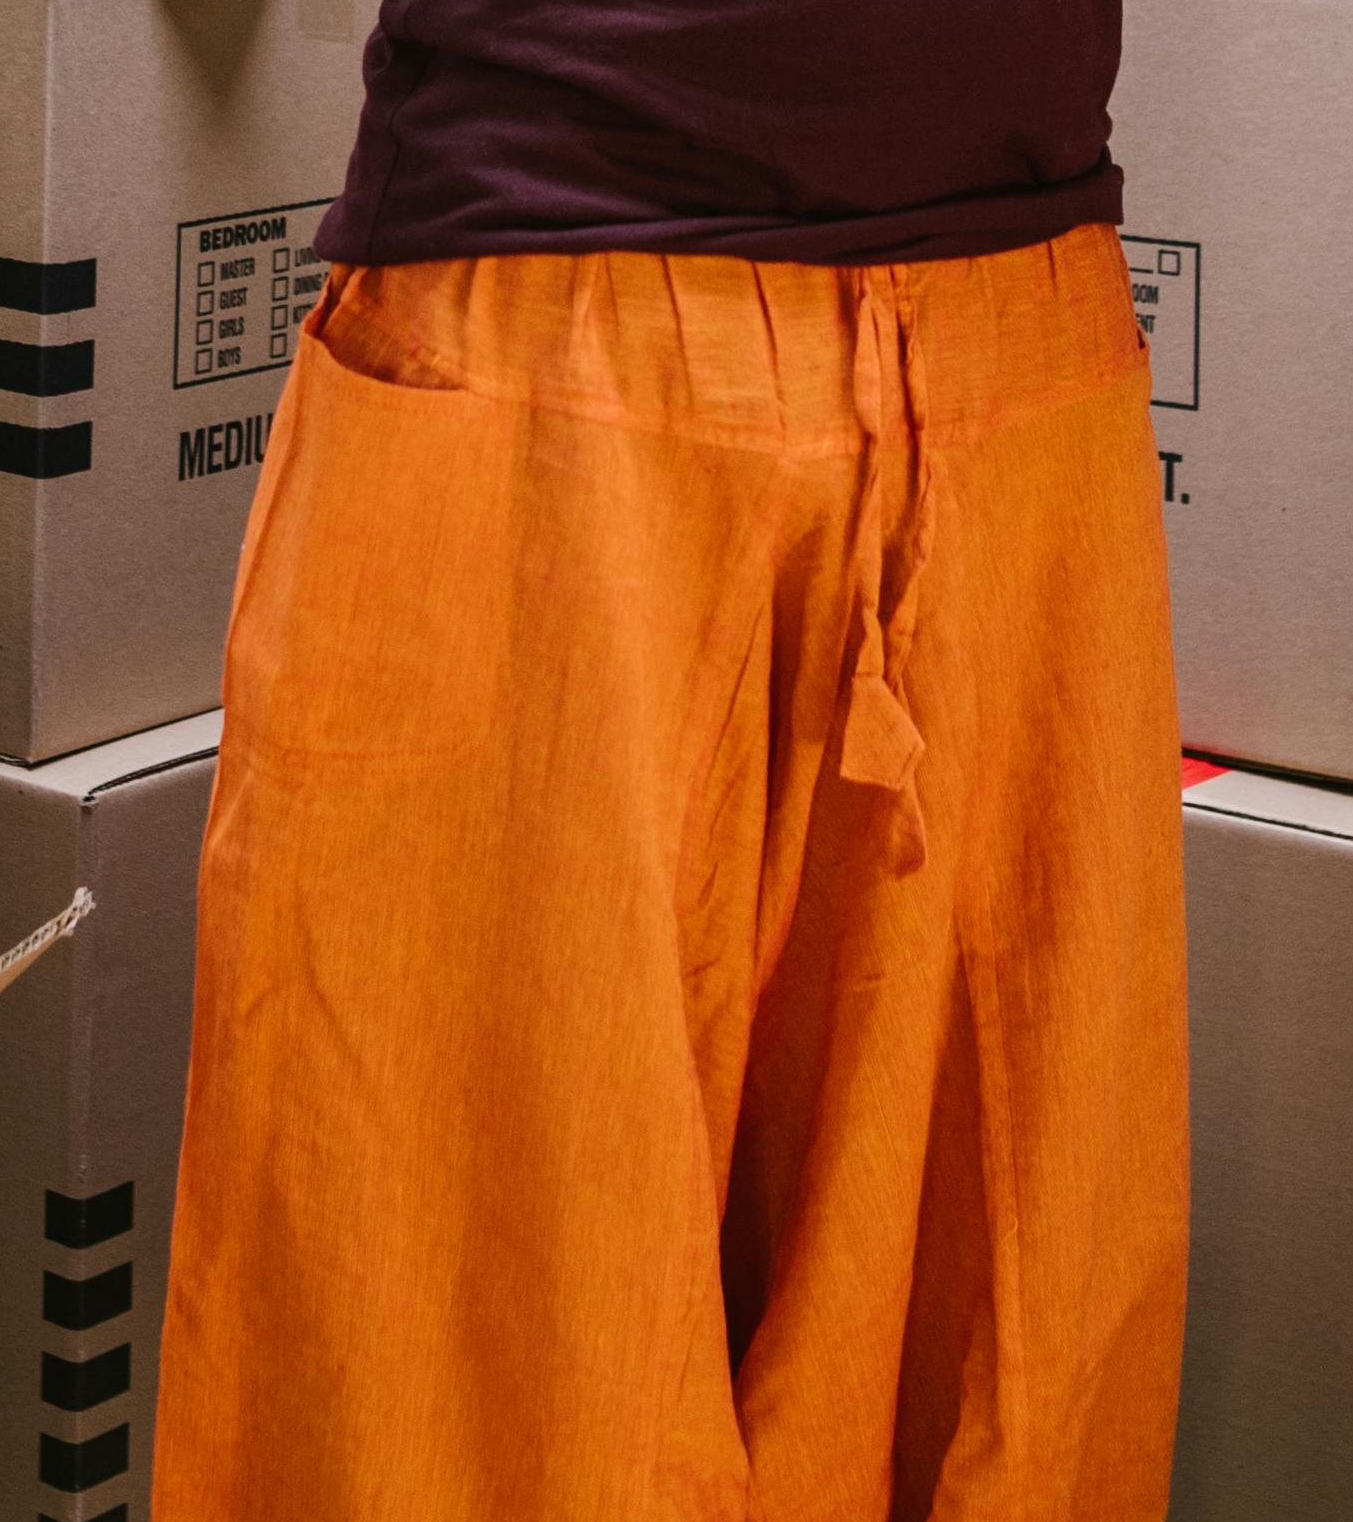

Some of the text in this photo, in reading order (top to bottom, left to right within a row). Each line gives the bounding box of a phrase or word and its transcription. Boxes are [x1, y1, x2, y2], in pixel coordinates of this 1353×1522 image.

[199, 216, 287, 253] BEDROOM
[220, 257, 256, 281] MASTER
[219, 287, 248, 310] GUEST
[219, 316, 245, 340] GIRLS
[217, 346, 242, 369] BOYS
[178, 412, 274, 482] MEDIU
